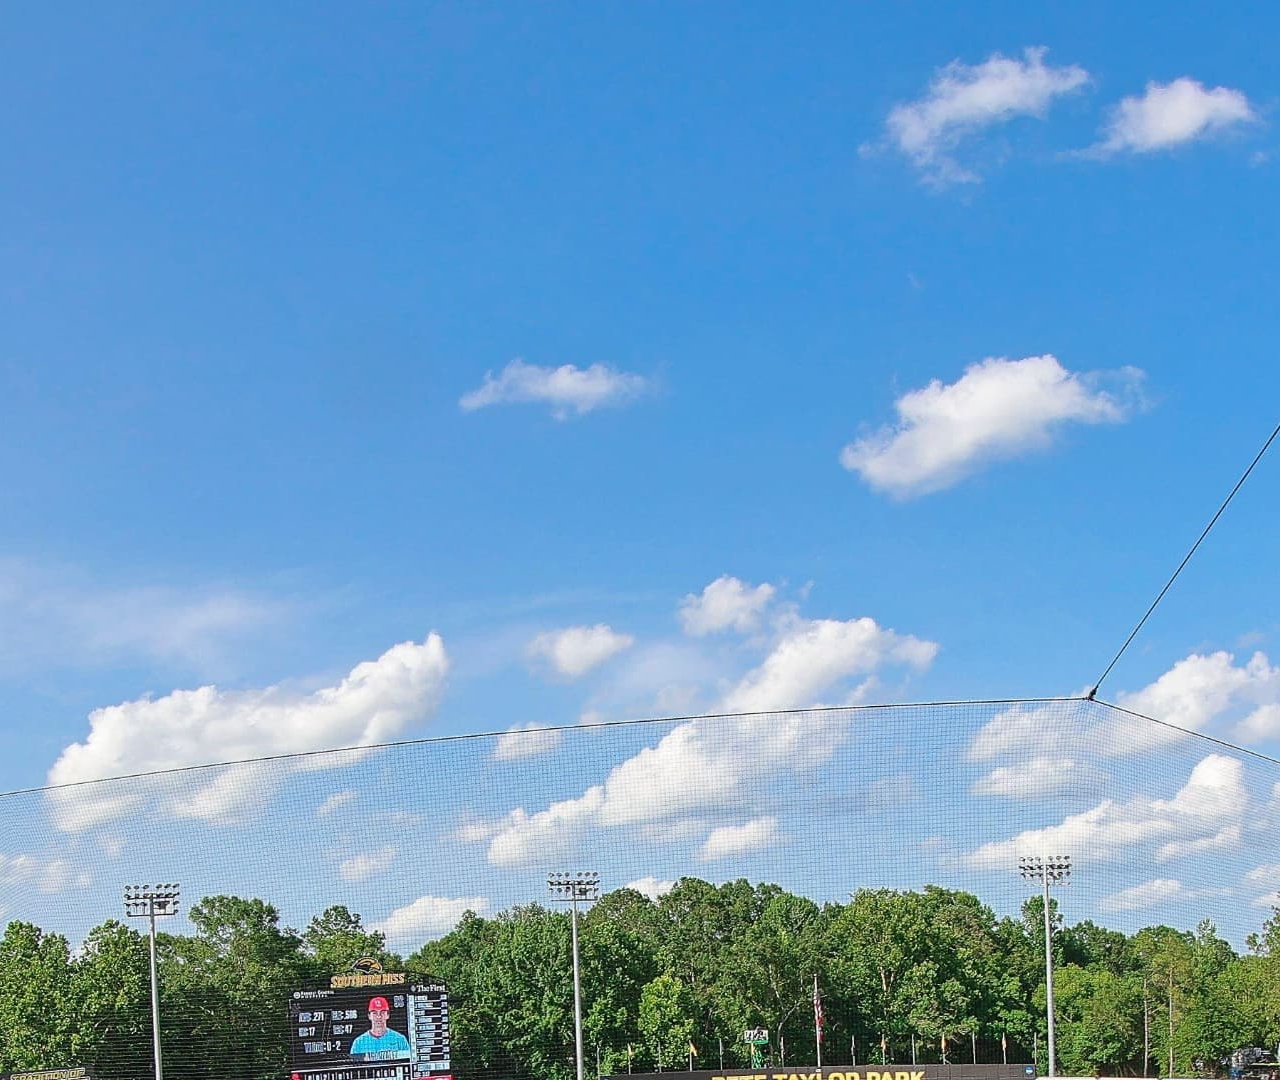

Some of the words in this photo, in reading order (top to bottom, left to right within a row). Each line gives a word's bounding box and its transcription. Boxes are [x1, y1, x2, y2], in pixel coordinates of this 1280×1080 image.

[330, 974, 381, 988] SOUTHERN
[381, 973, 405, 985] MISS
[70, 1068, 85, 1078] OF
